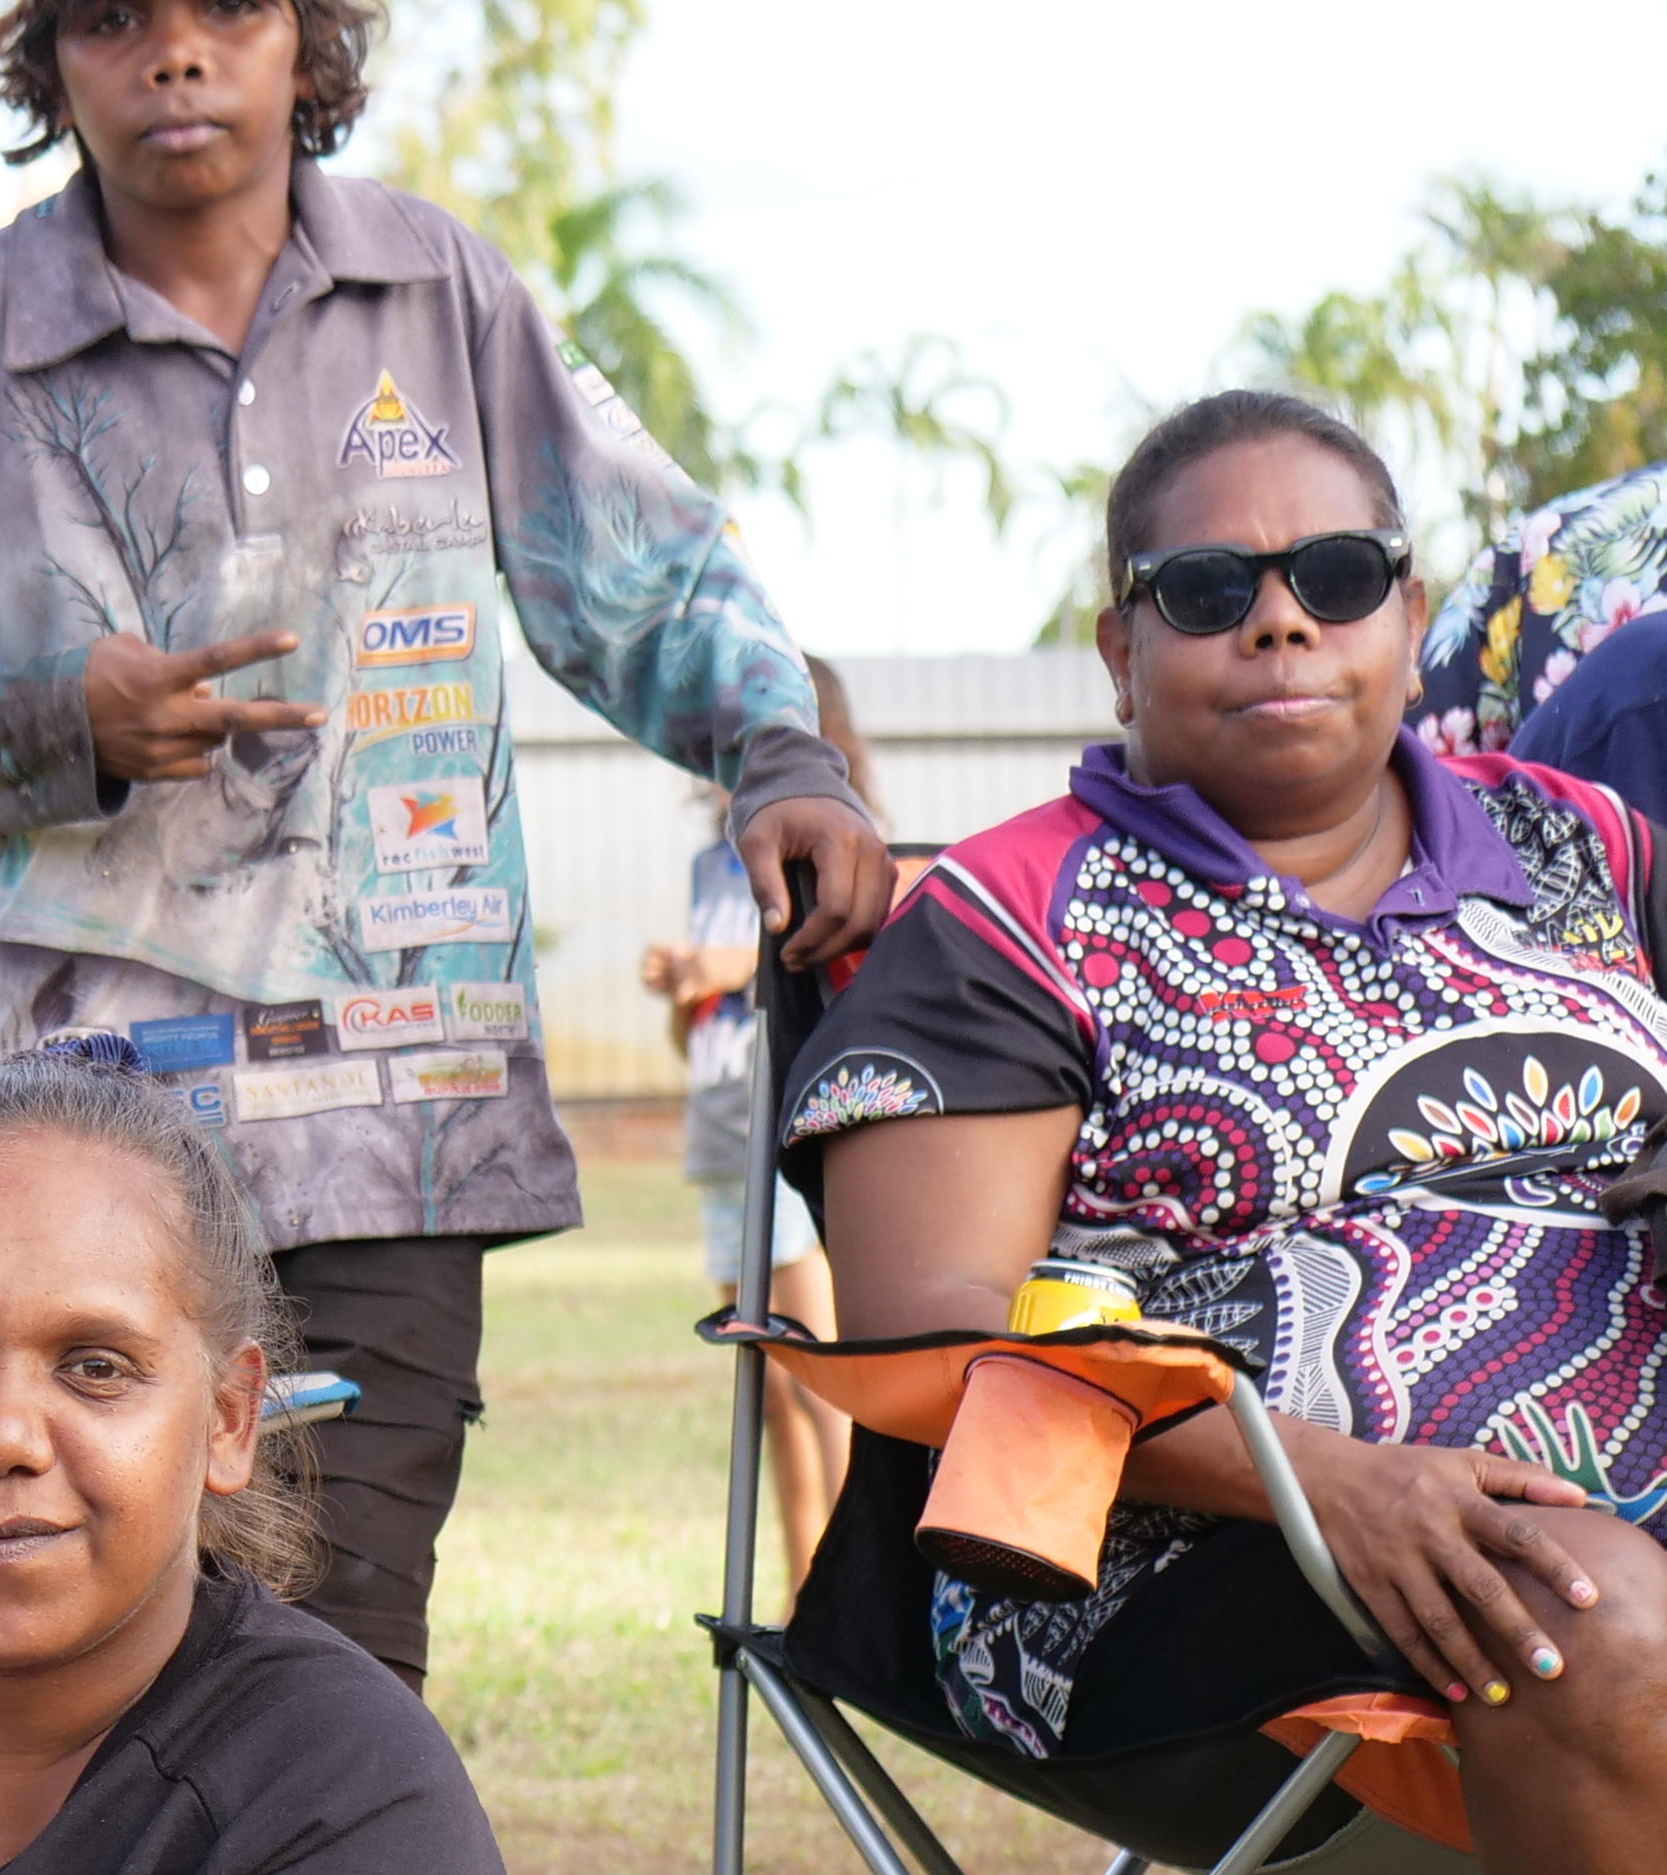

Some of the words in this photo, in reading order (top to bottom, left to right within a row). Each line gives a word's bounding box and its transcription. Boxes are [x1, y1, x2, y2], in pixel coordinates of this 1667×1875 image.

[340, 398, 460, 477] Apex
[363, 615, 465, 650] OMS
[413, 730, 477, 755] POWER
[370, 896, 477, 925] Kimberley
[482, 895, 503, 916] Air
[361, 1003, 435, 1028] KAS
